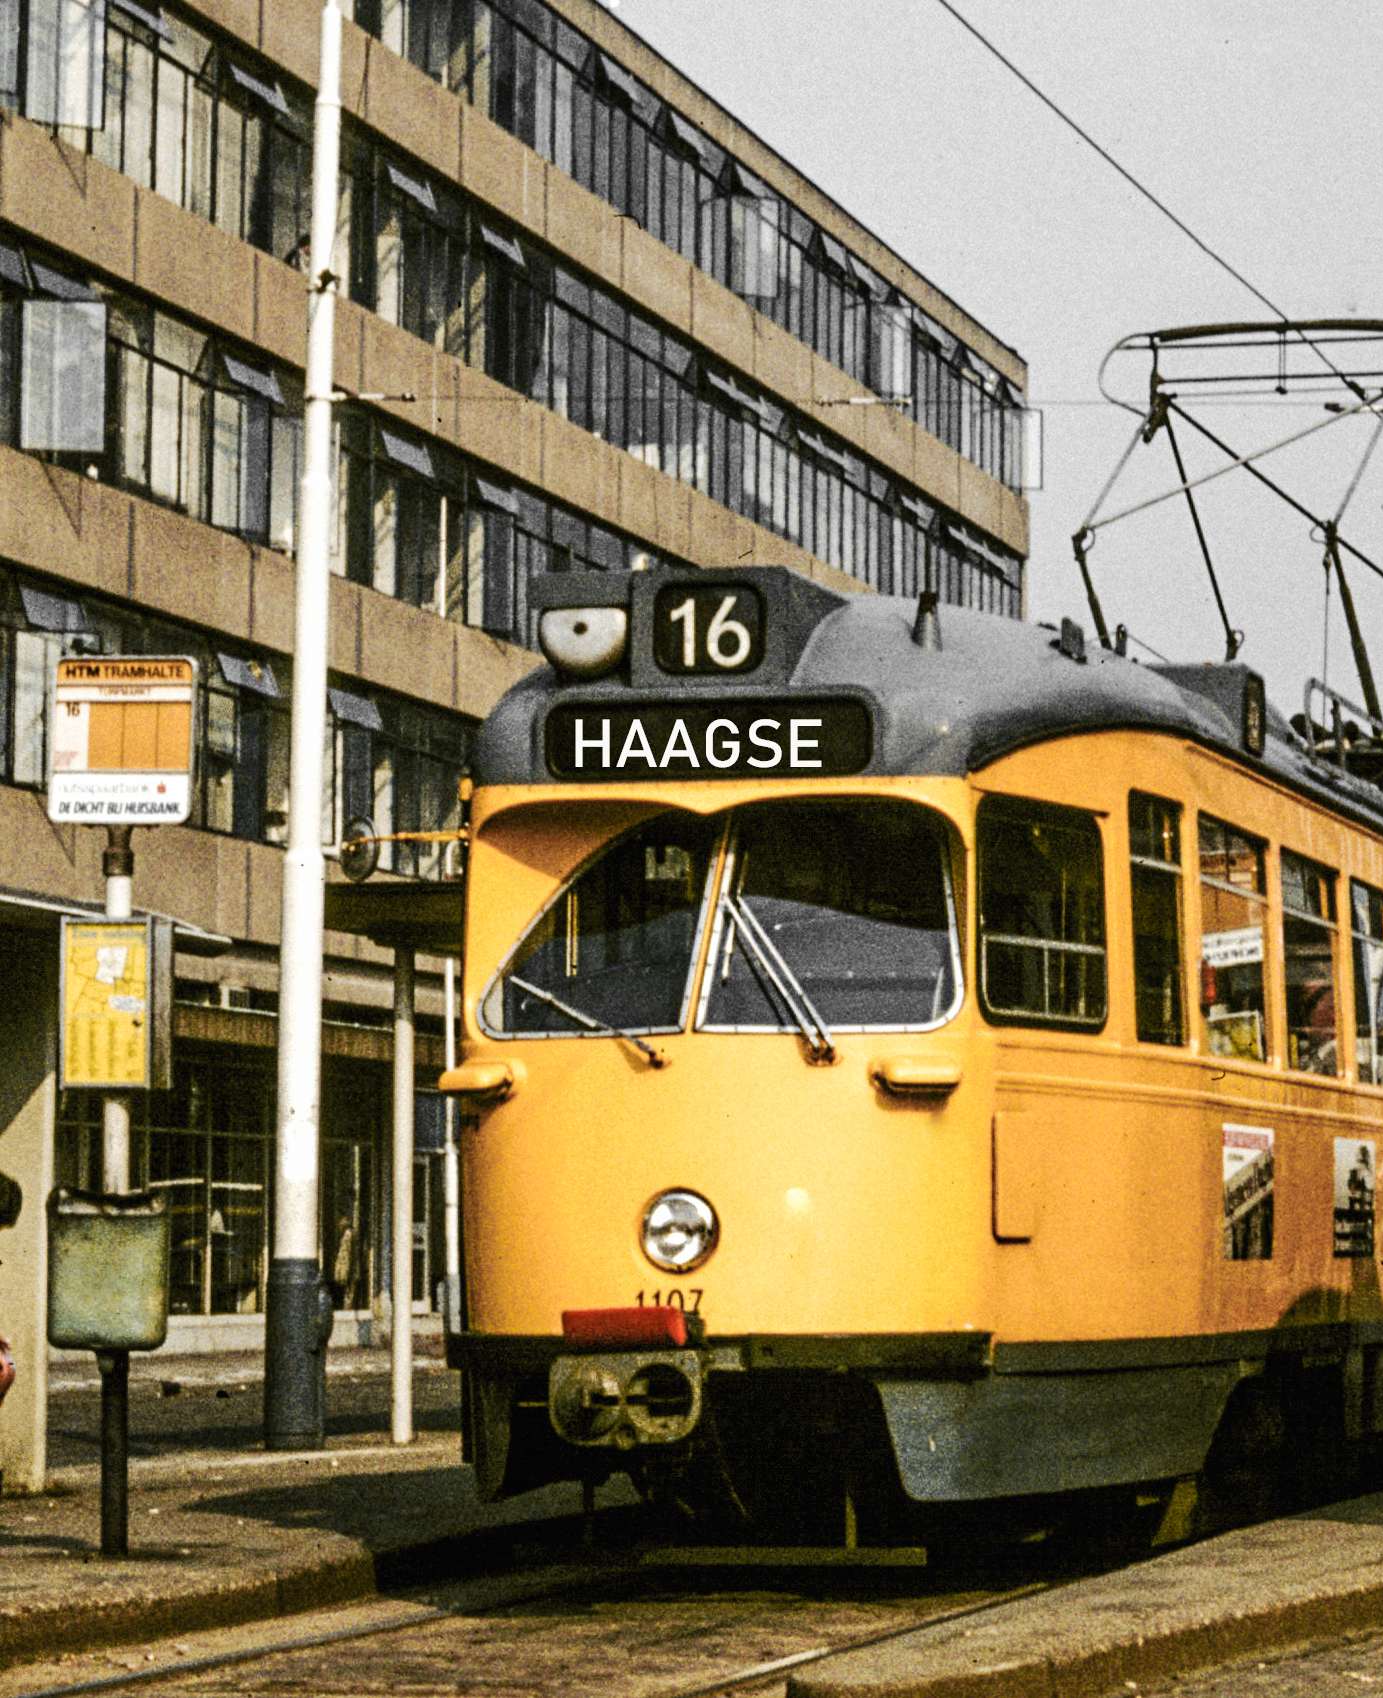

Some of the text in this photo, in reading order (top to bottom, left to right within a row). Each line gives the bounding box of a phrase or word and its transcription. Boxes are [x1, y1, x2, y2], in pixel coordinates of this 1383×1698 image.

[670, 596, 751, 668] 16
[66, 665, 184, 678] HTM TRAMHALTE
[66, 701, 80, 717] 16
[574, 718, 823, 768] HAAGSE
[58, 801, 71, 814] DE
[74, 801, 105, 814] DICHT
